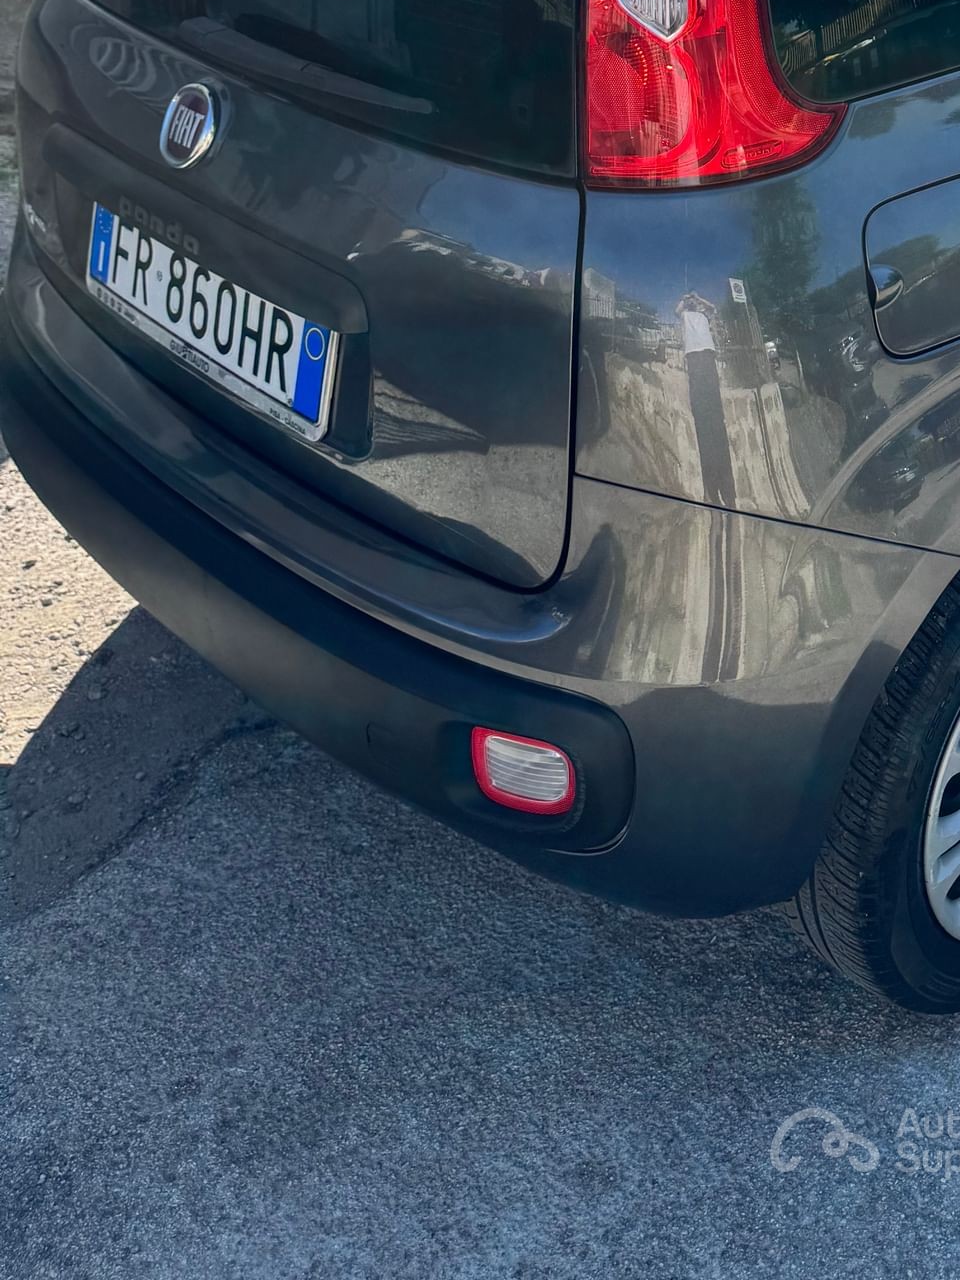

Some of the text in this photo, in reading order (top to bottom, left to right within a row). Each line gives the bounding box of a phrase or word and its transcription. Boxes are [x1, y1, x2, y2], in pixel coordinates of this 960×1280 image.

[169, 104, 205, 149] FIAT
[112, 222, 294, 394] FR 860HR
